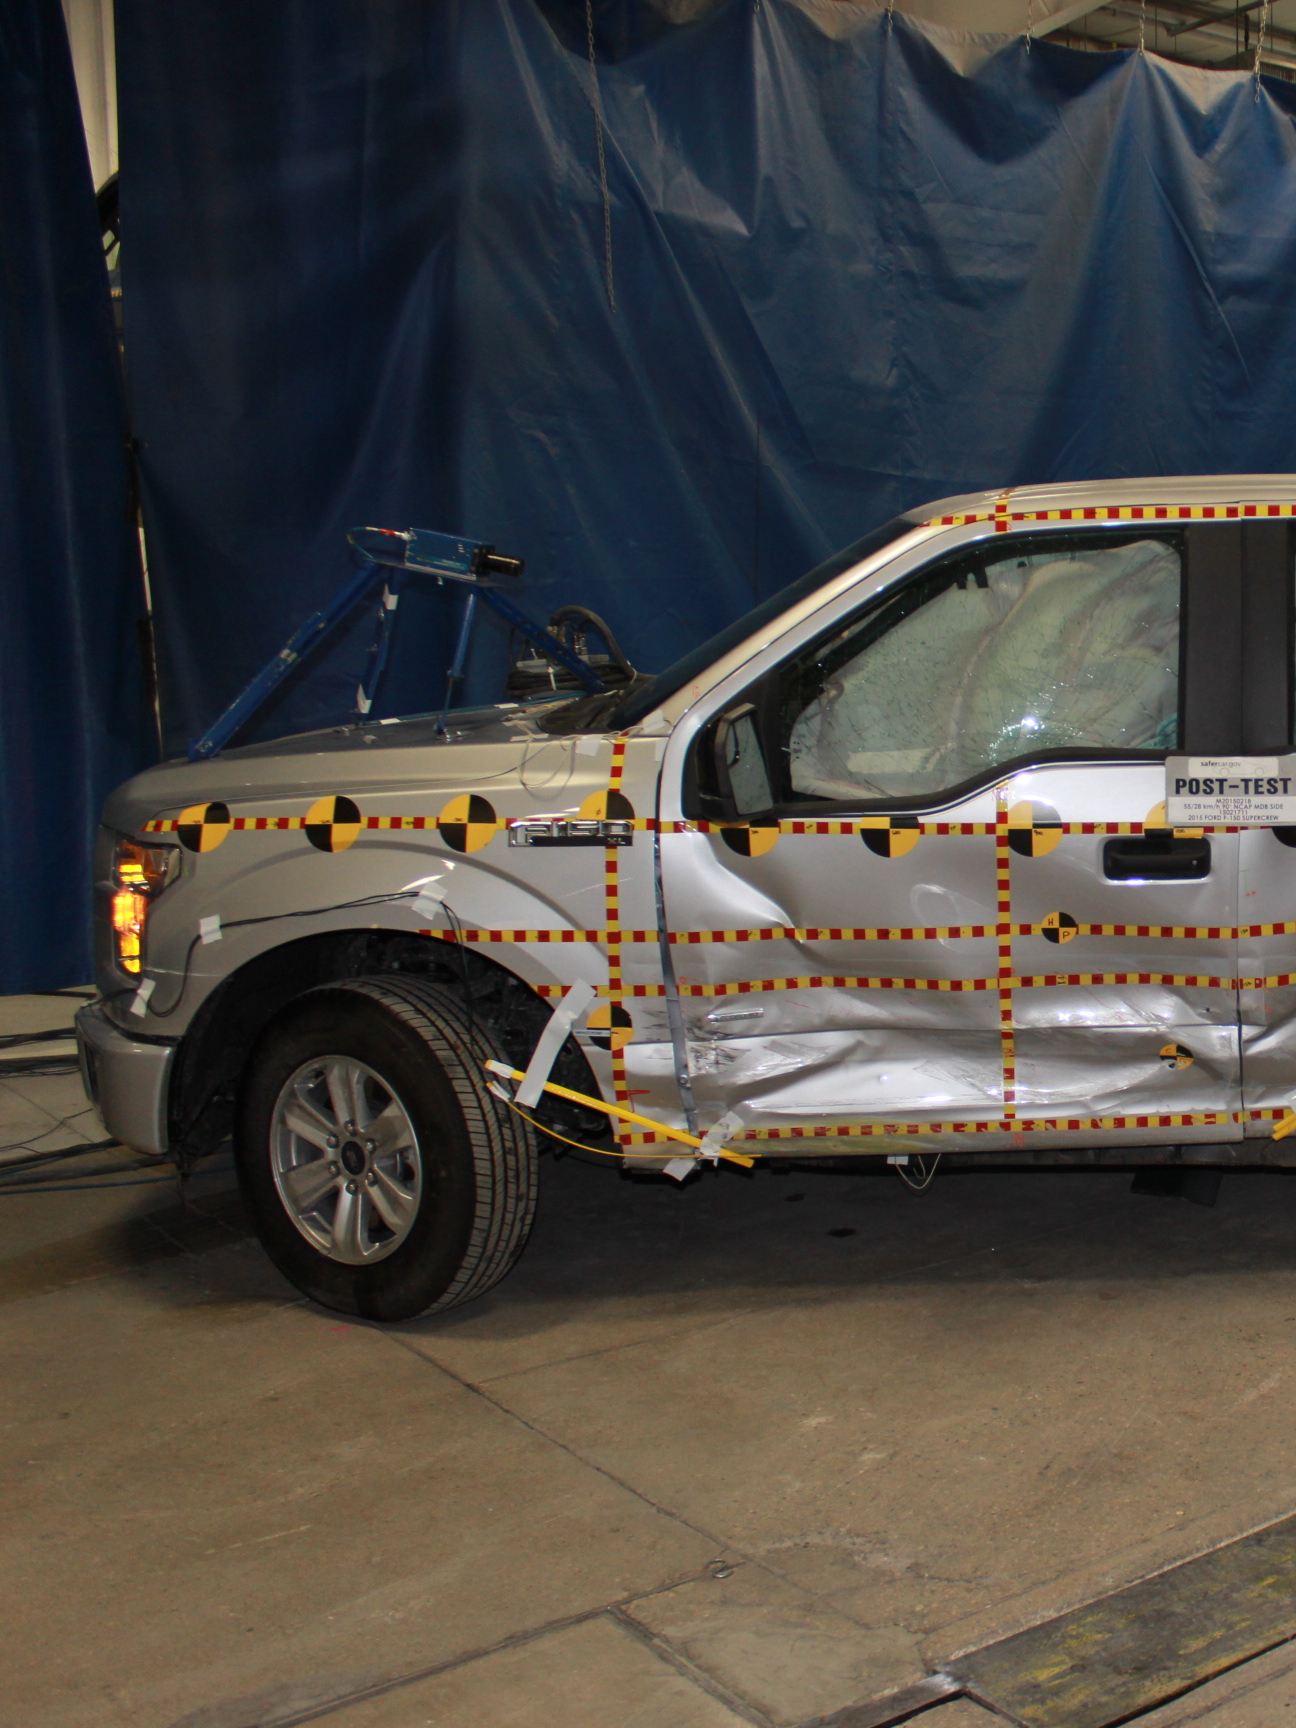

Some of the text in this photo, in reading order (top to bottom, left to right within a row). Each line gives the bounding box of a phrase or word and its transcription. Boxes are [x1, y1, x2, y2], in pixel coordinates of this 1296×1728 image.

[1200, 760, 1241, 768] safercar.gov
[1175, 777, 1292, 795] POST-TEST
[606, 837, 626, 845] XL
[1047, 917, 1054, 927] H
[1062, 930, 1071, 939] P
